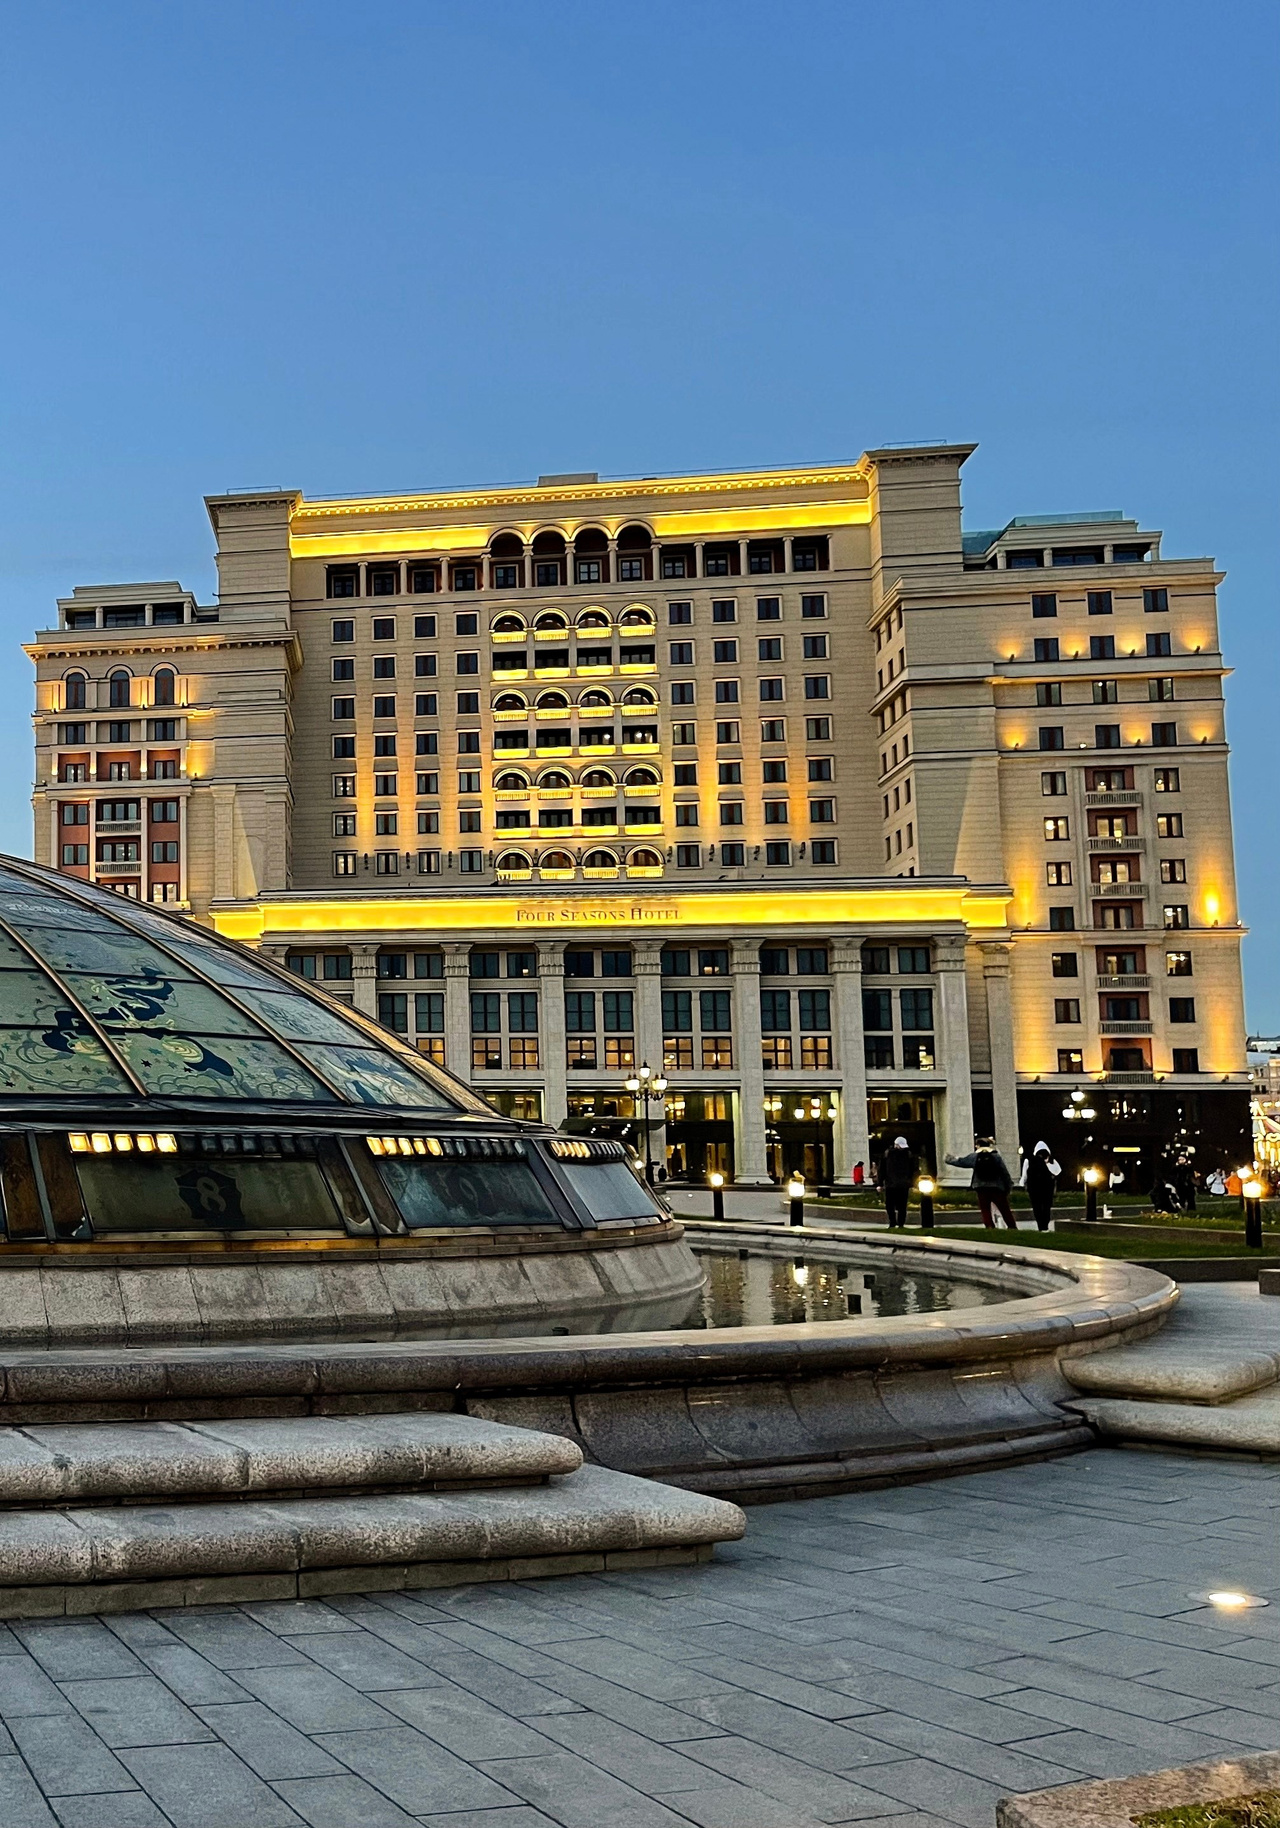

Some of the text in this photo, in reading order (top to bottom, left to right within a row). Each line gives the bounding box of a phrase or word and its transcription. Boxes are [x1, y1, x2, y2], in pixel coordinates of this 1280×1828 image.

[516, 907, 683, 922] FOUR SEASONS HOTEL
[196, 1176, 227, 1213] 8
